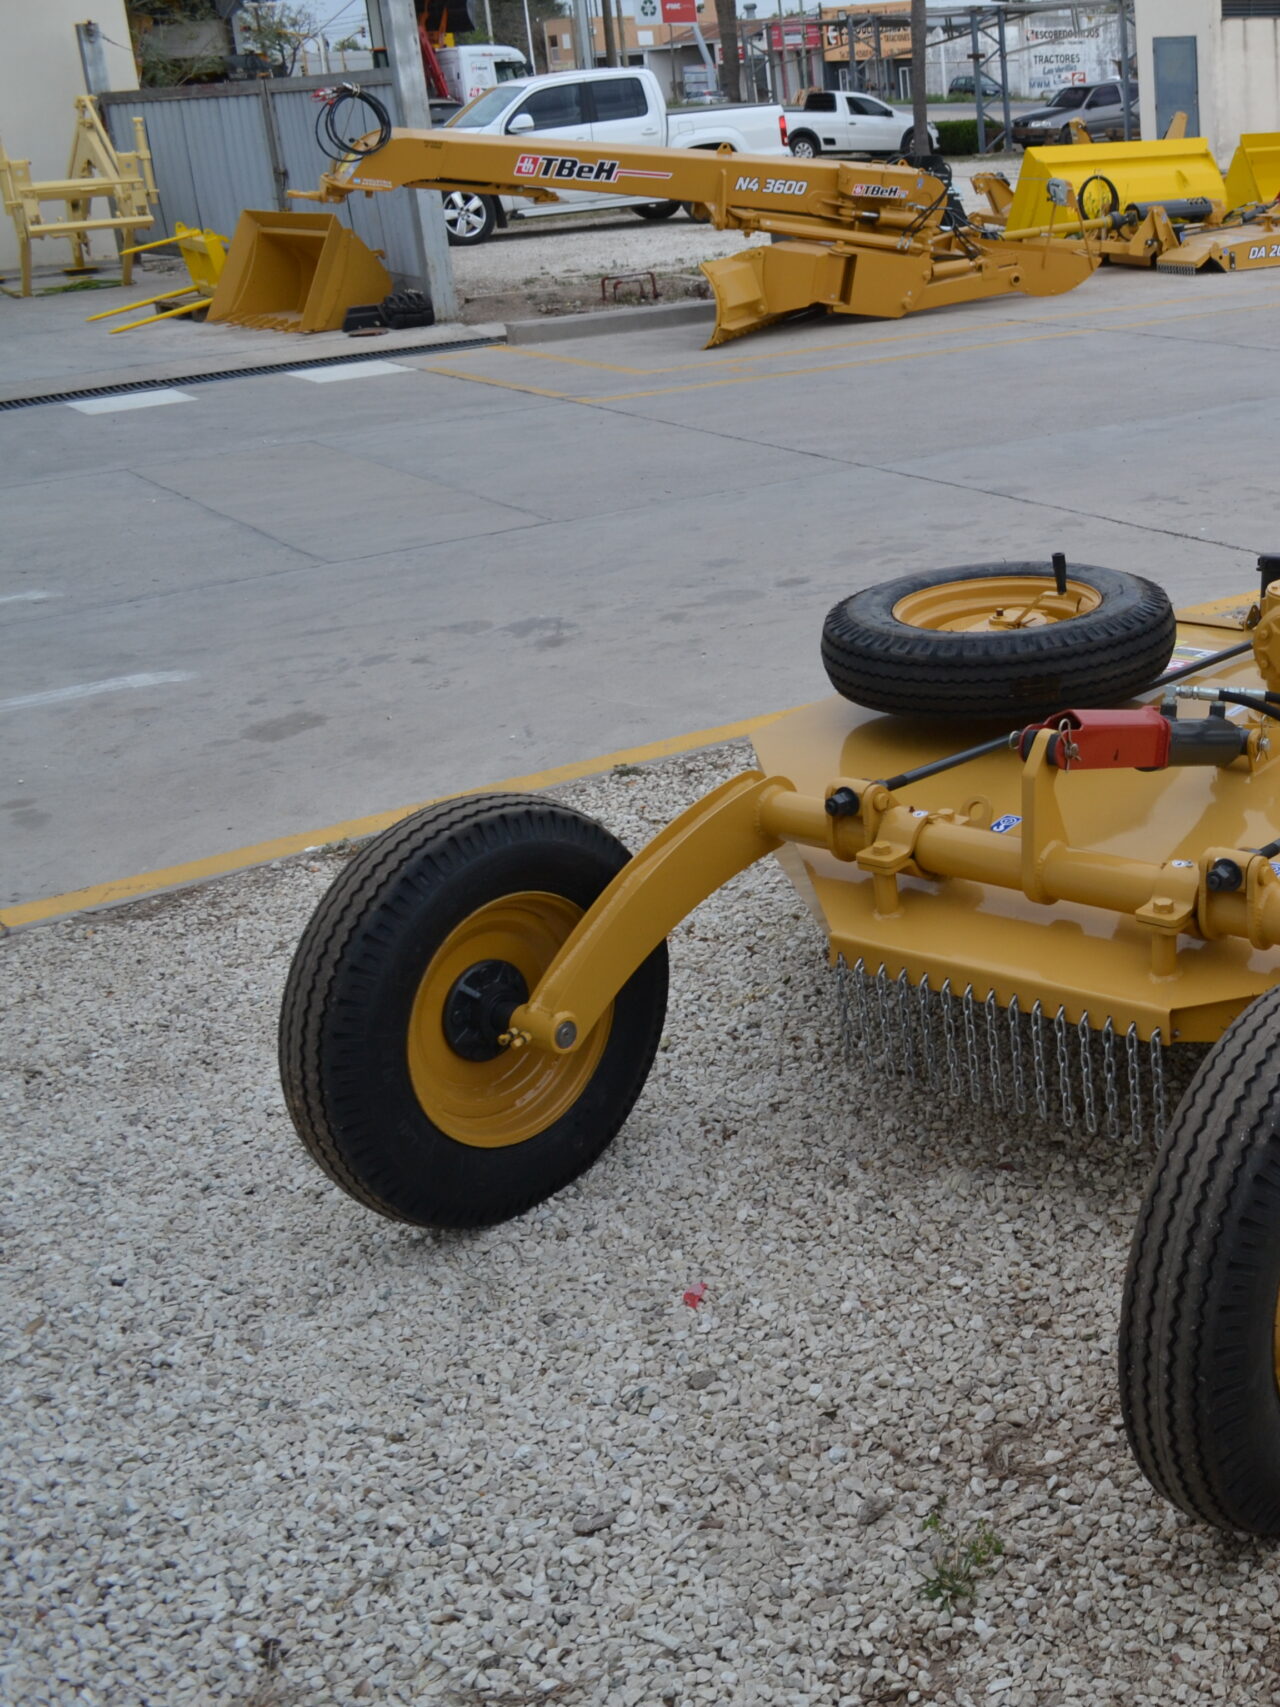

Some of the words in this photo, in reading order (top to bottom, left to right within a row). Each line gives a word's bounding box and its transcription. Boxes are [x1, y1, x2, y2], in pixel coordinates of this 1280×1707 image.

[1033, 54, 1080, 65] TRACTORES
[541, 156, 618, 182] TBeH
[735, 176, 760, 192] N4
[762, 178, 808, 195] 3600
[862, 185, 901, 198] TBeH
[1248, 246, 1266, 259] DA
